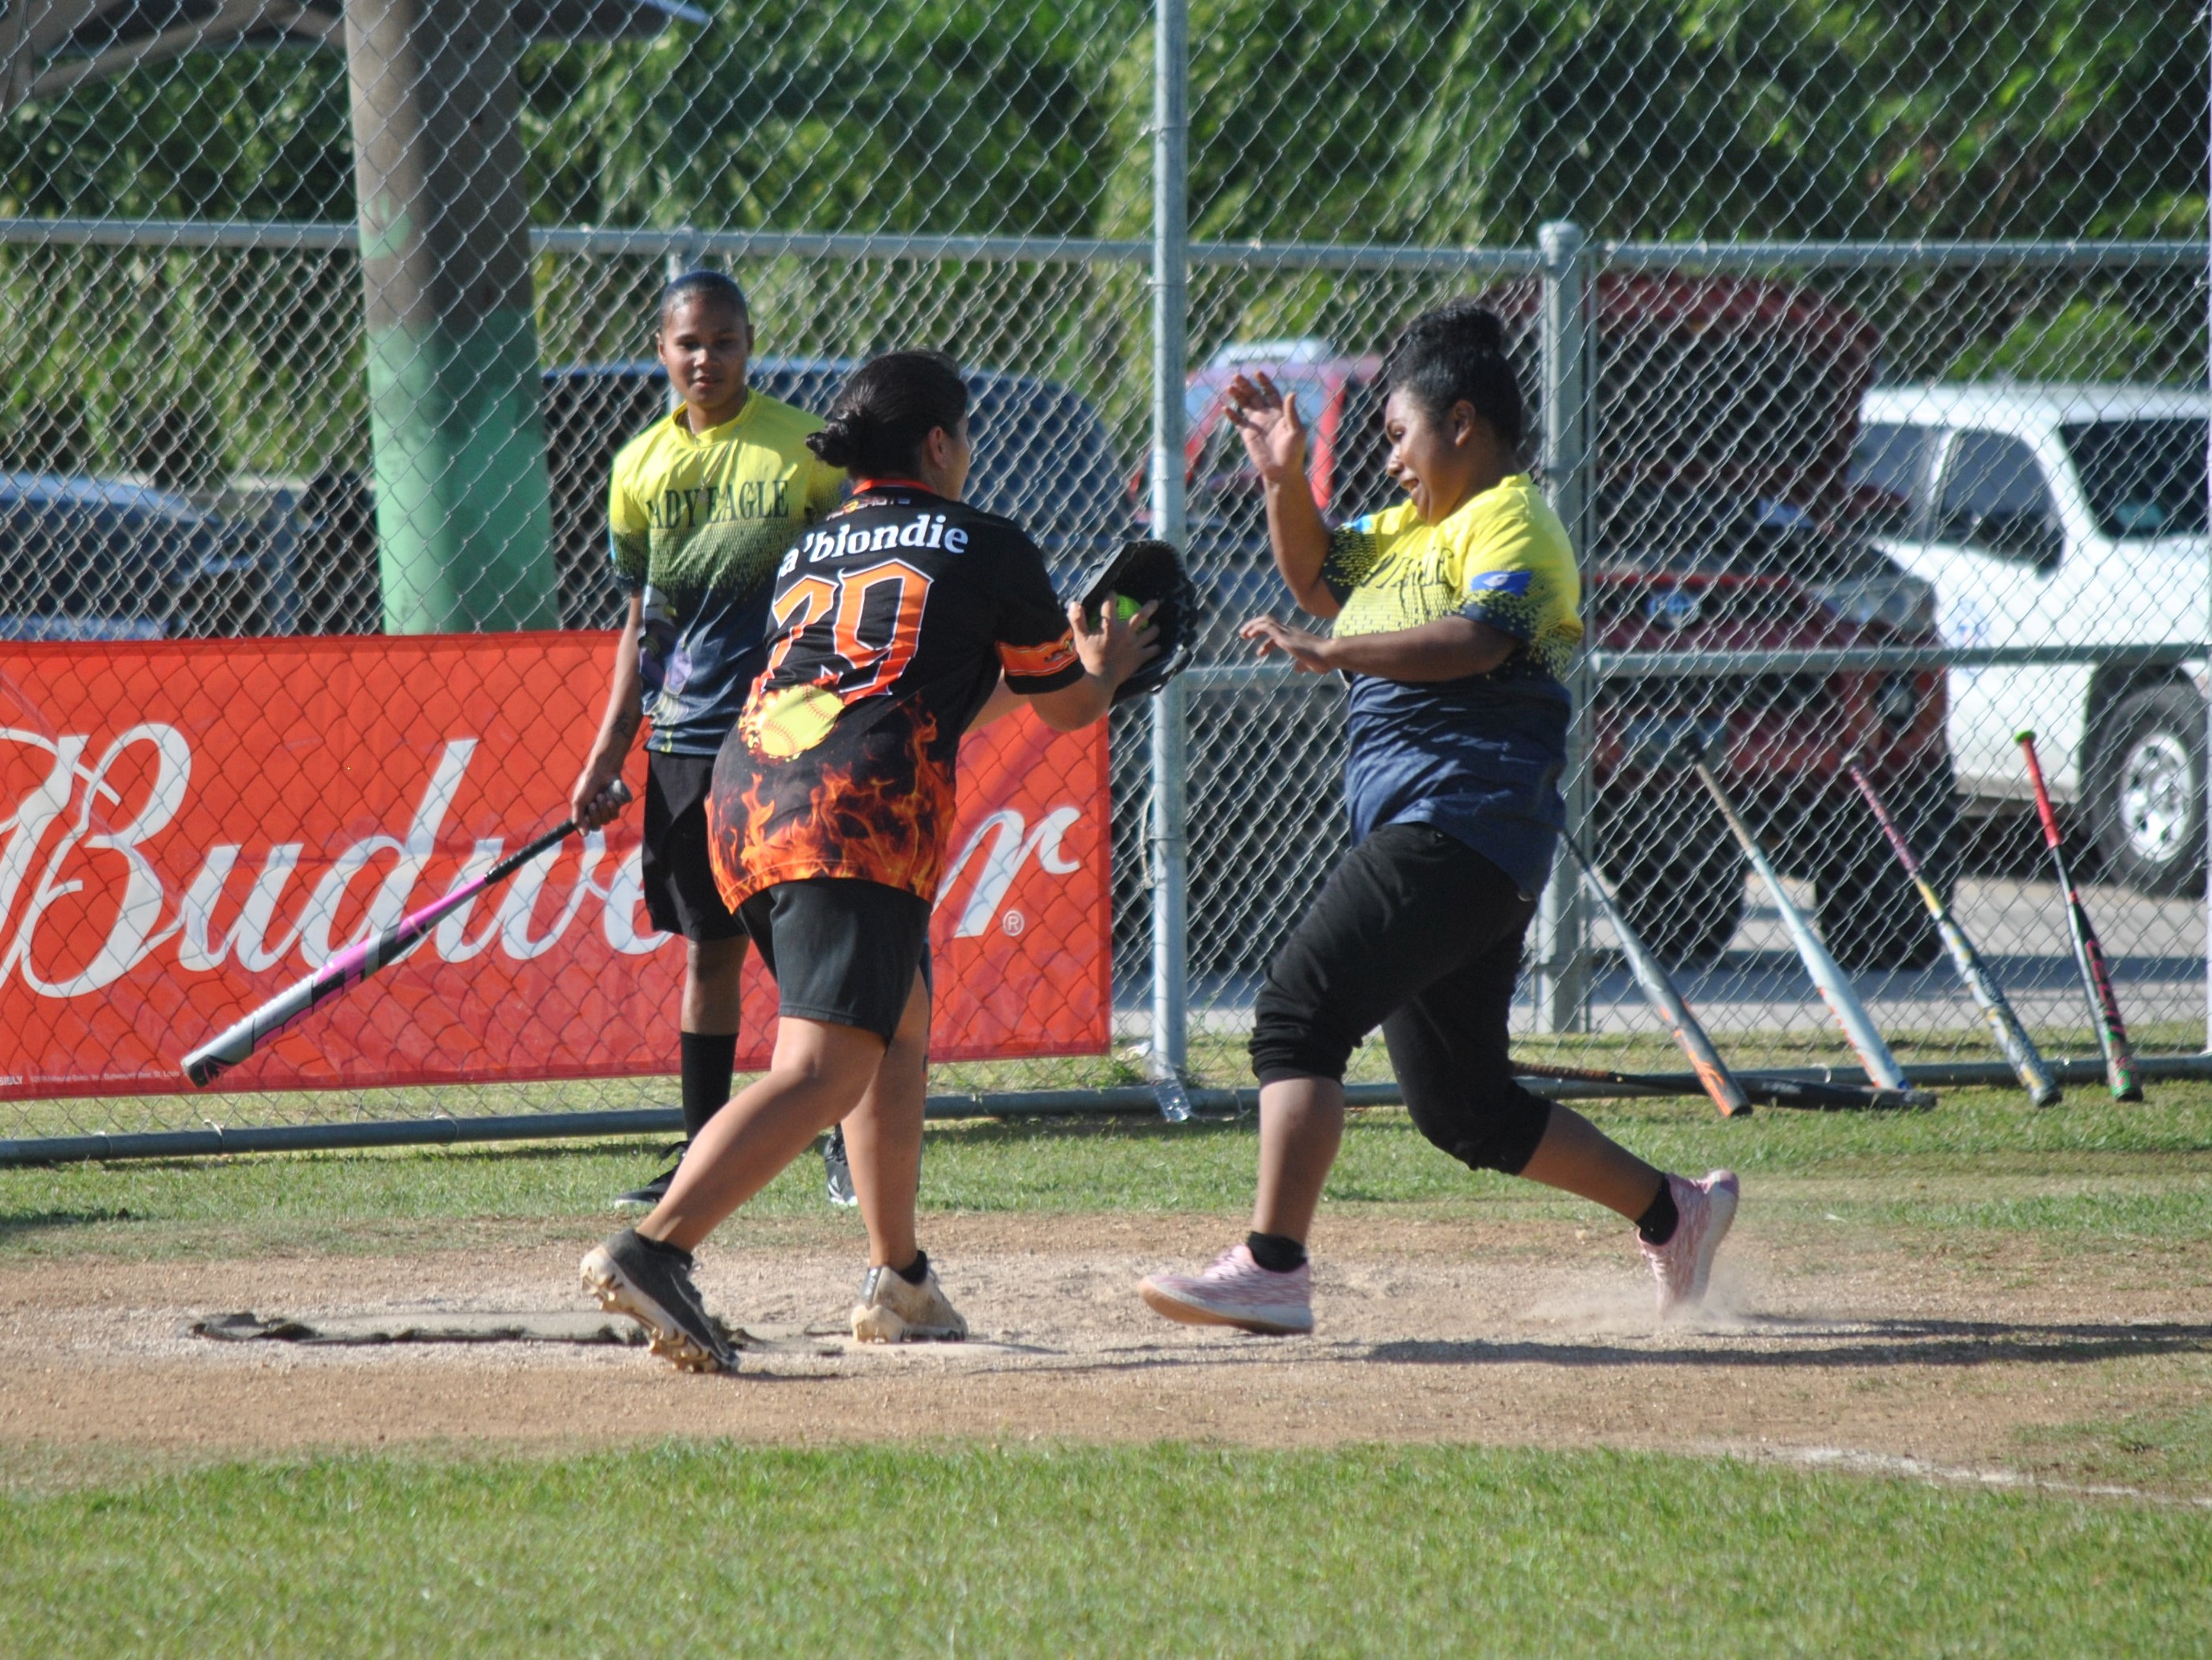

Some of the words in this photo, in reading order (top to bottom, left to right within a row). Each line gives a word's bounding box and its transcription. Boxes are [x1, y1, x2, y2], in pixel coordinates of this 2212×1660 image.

[645, 487, 701, 529] ADY
[705, 479, 790, 525] EAGLE
[777, 513, 969, 580] a'blondie
[0, 722, 1082, 1000] Budwer
